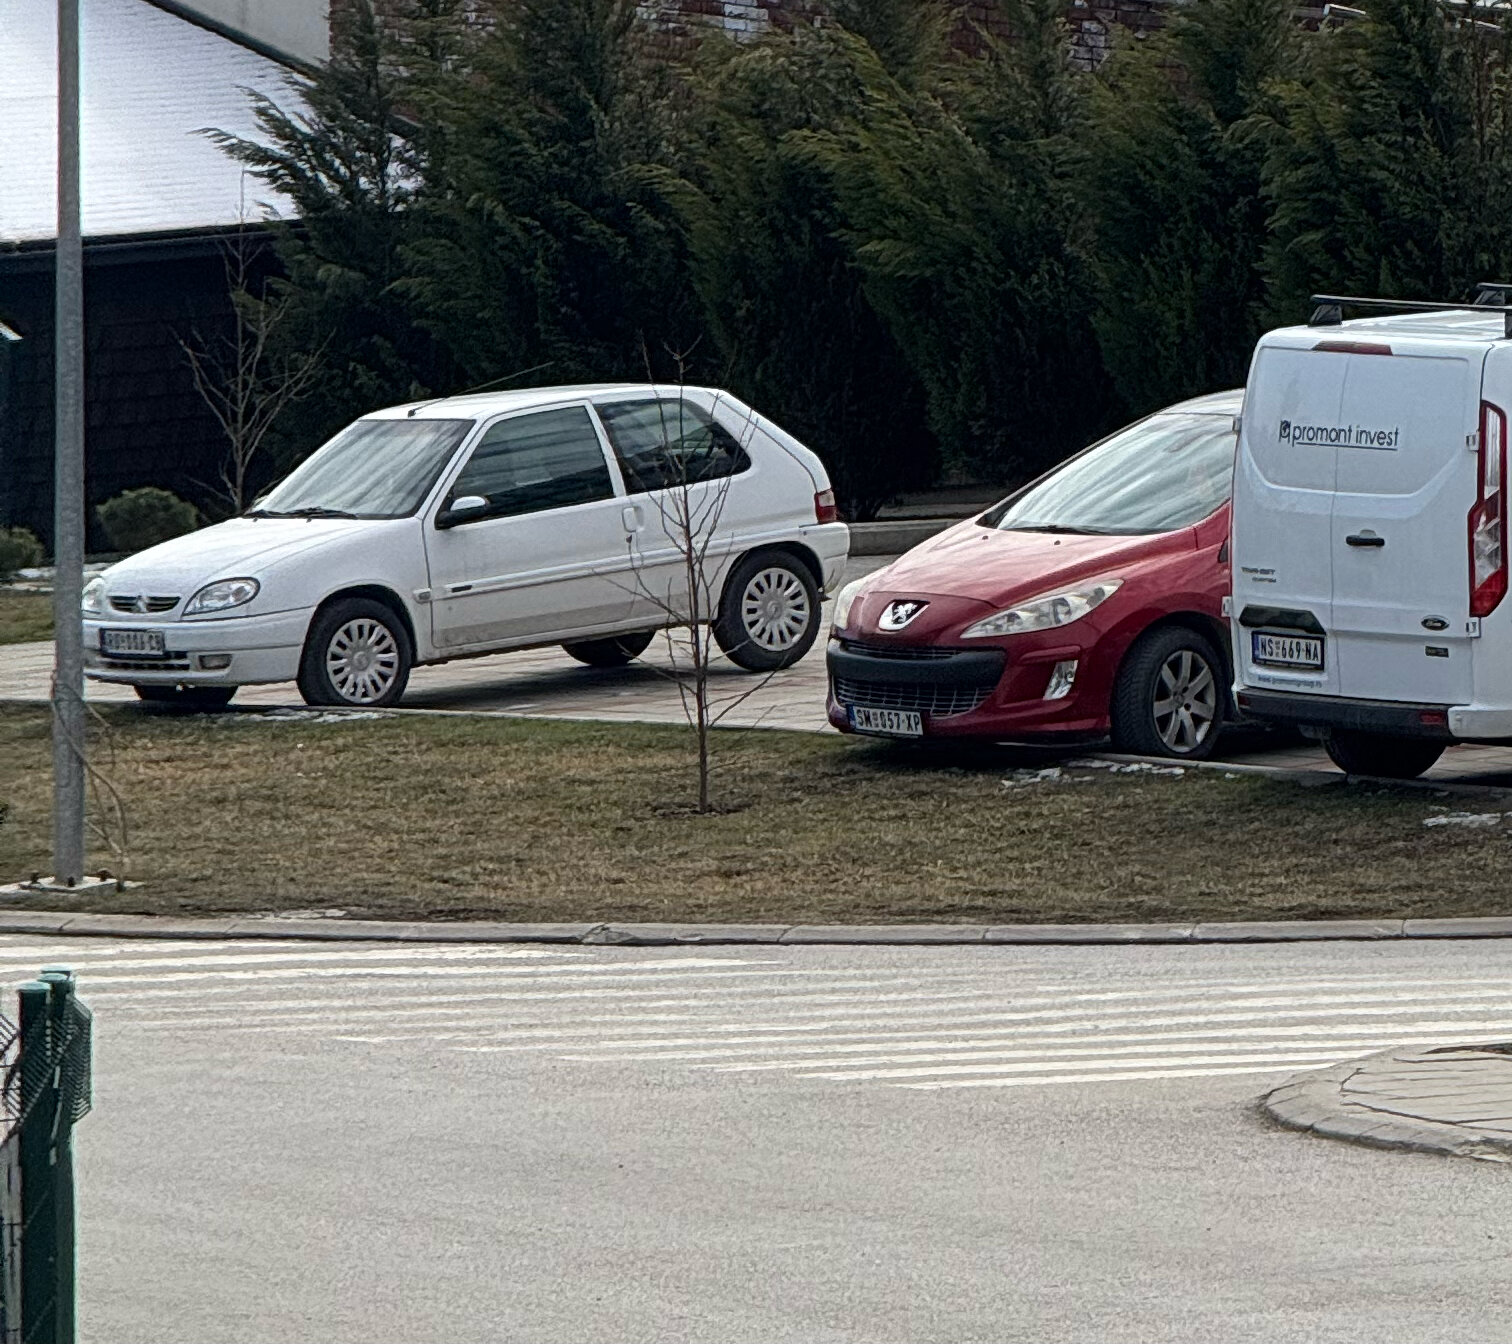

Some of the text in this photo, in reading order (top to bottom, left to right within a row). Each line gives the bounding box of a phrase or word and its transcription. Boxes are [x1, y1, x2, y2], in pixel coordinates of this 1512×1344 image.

[1291, 423, 1399, 448] promont invest
[1260, 637, 1274, 657] NS
